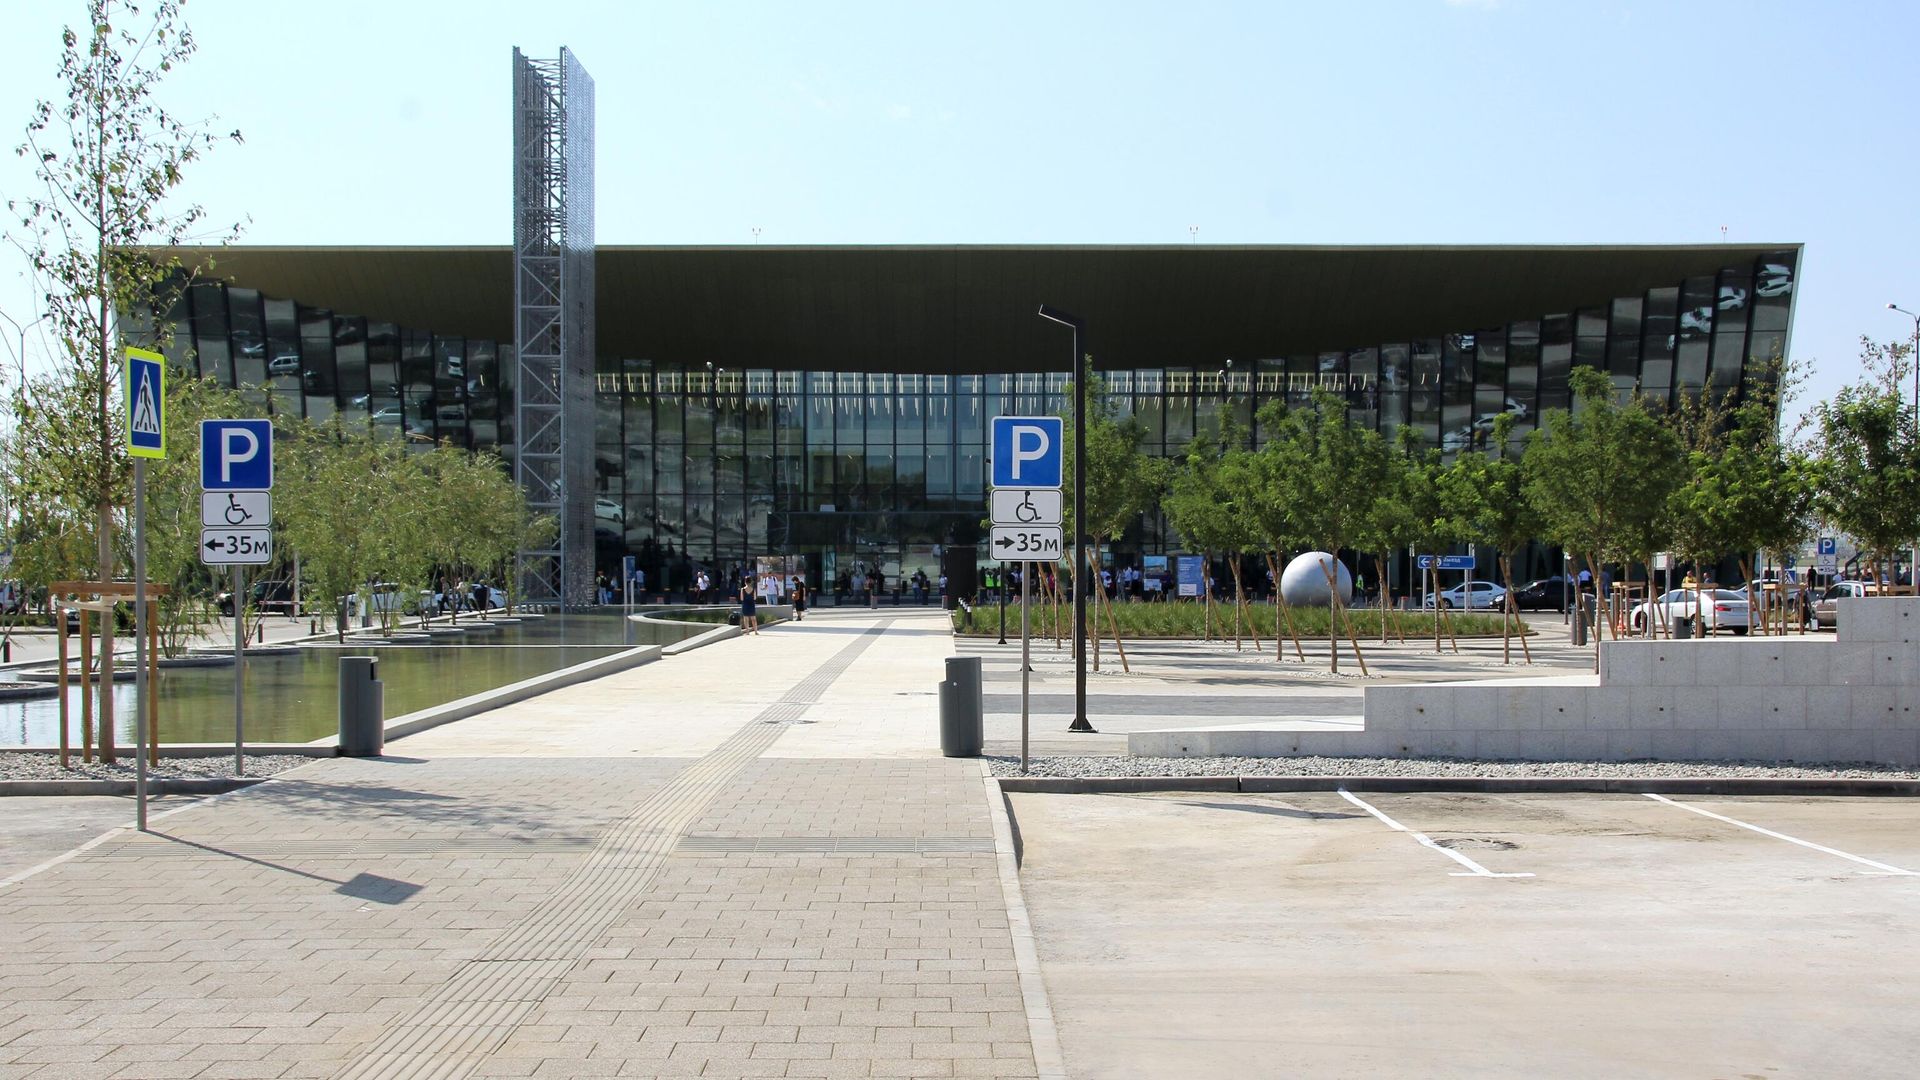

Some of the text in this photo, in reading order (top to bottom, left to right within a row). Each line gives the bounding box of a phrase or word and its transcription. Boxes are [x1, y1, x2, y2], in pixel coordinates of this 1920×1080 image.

[221, 427, 259, 482] P
[1012, 425, 1050, 480] P
[1822, 540, 1832, 553] P
